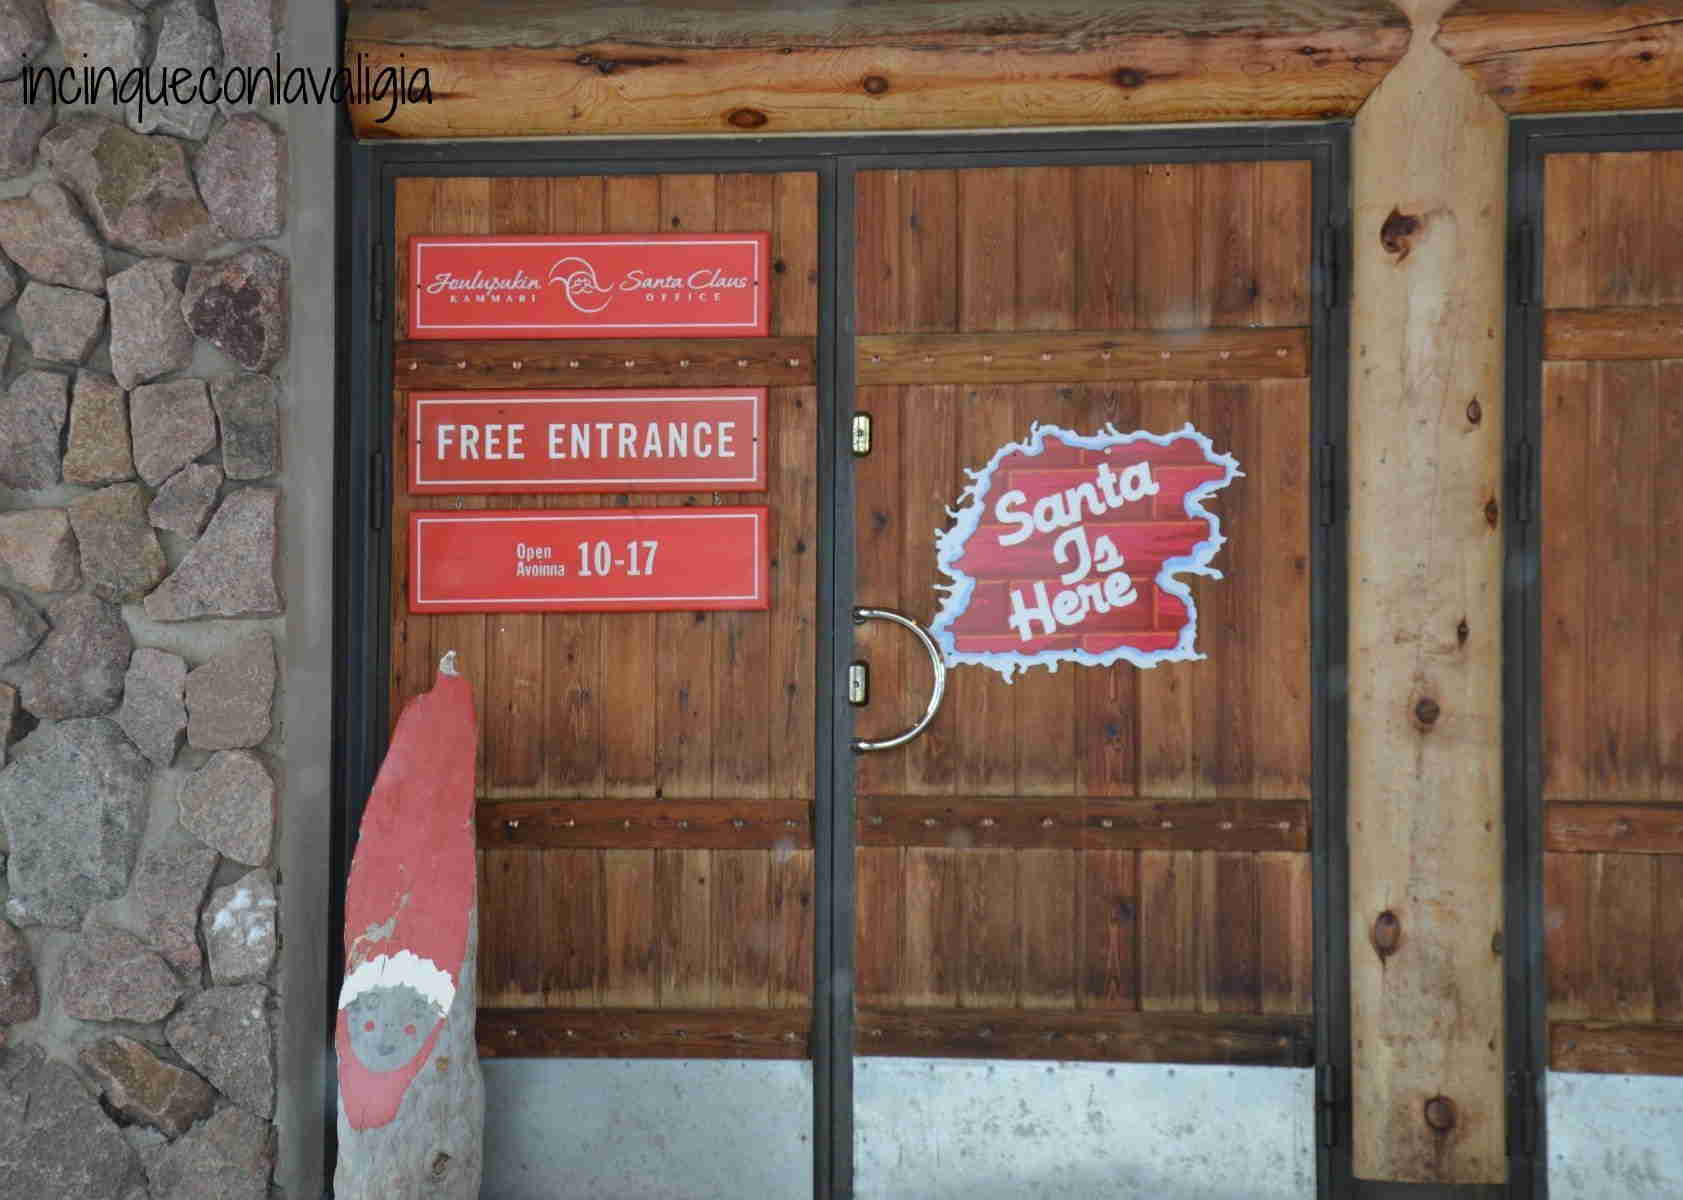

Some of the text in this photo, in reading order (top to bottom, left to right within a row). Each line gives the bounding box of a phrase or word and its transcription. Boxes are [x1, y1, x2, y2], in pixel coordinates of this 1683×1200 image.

[619, 269, 749, 291] Santa Claus
[646, 293, 722, 302] OFFICE
[450, 295, 537, 304] KAMMARI
[436, 421, 737, 460] FREE ENTRANCE
[994, 460, 1160, 546] Santa
[516, 543, 553, 560] Open
[577, 540, 659, 577] 10-17
[1053, 525, 1124, 585] Is
[1008, 571, 1138, 641] Here
